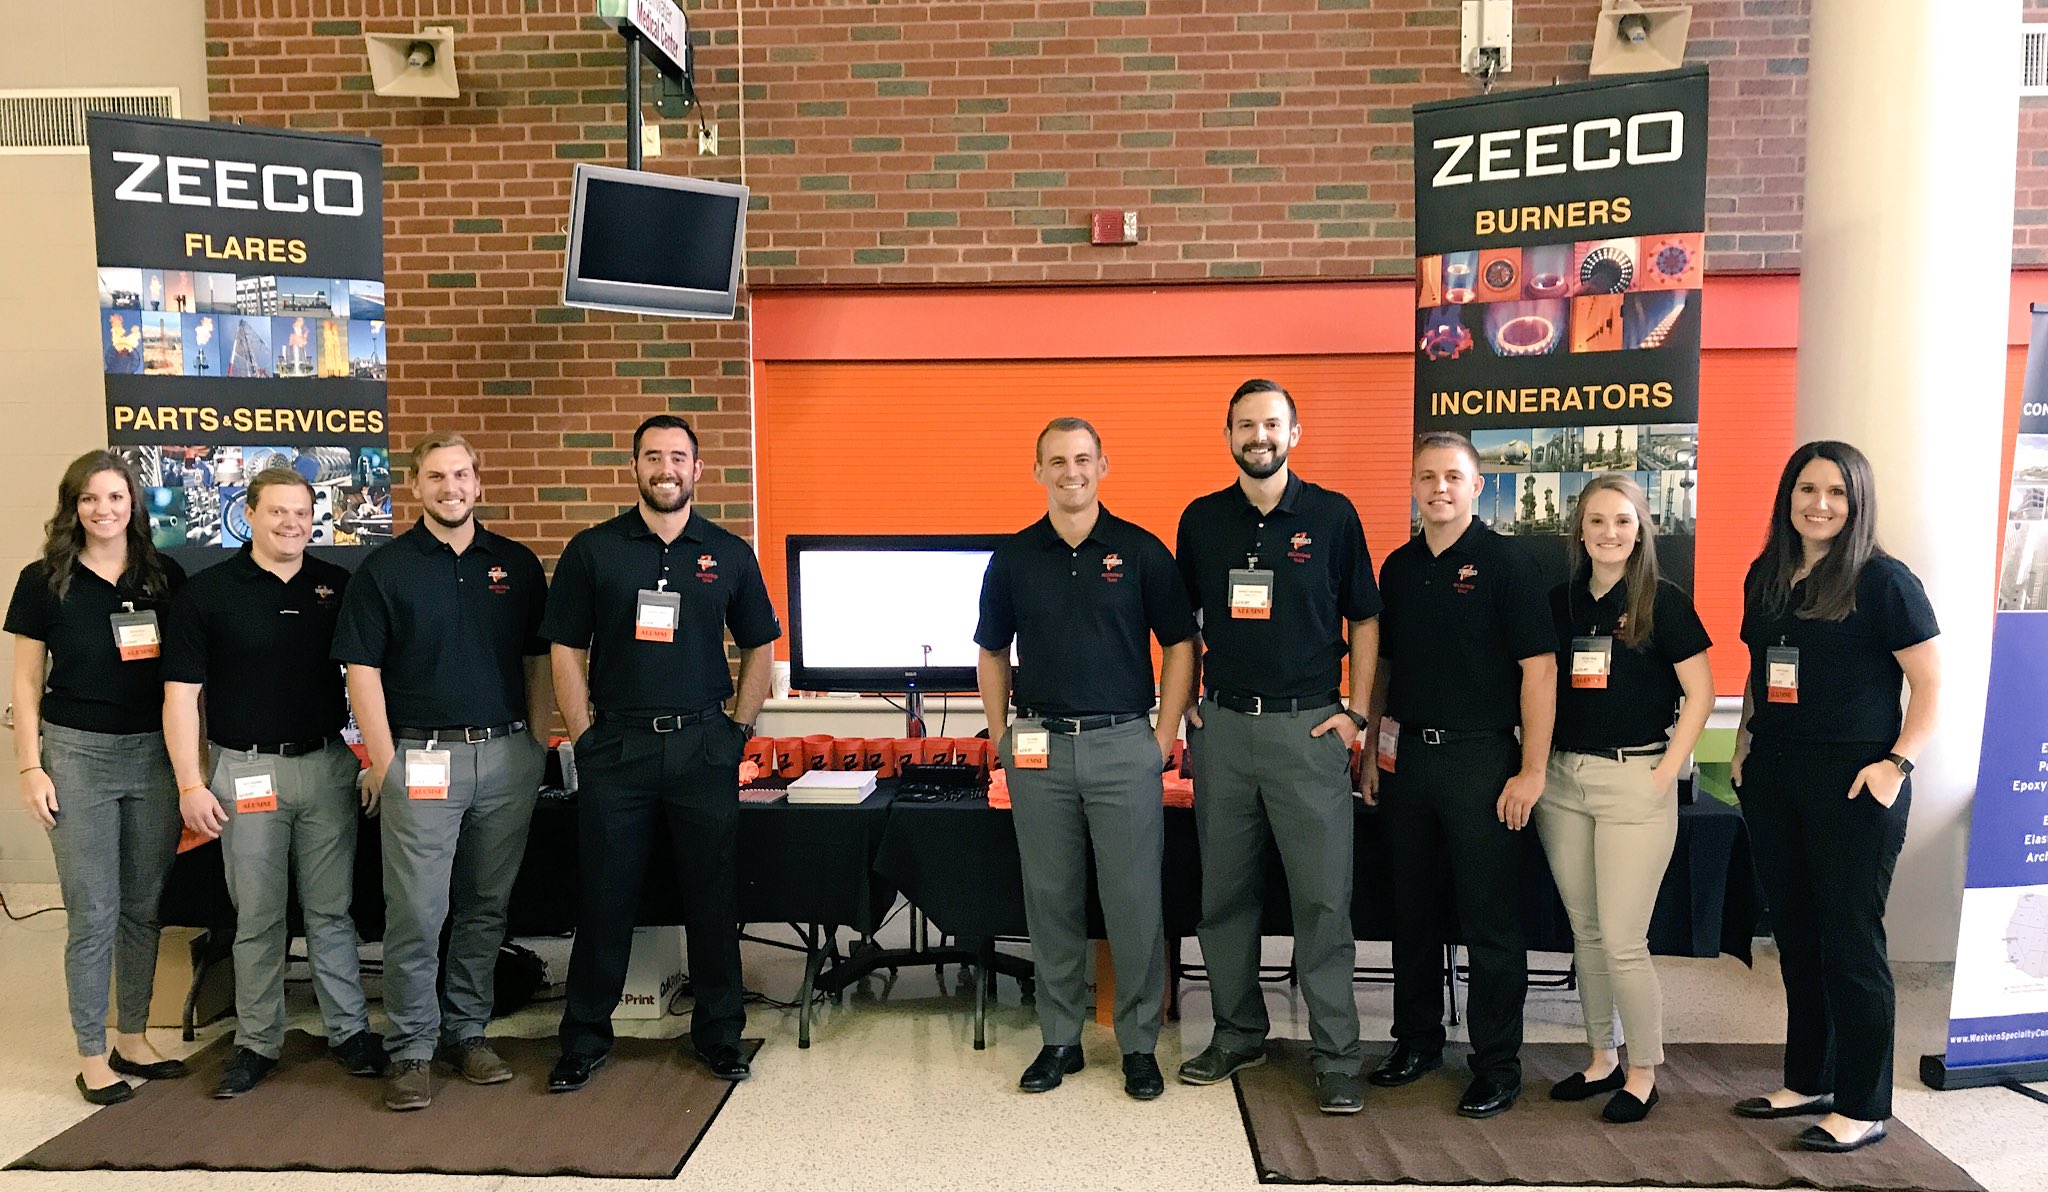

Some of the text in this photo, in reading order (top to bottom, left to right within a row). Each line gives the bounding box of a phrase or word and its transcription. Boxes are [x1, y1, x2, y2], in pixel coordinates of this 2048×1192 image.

[636, 0, 679, 59] Medical Center
[1432, 110, 1684, 188] ZEECO
[112, 151, 364, 217] ZEECO
[1475, 197, 1633, 236] BURNERS
[184, 233, 308, 264] FLARES
[1431, 381, 1674, 416] INCINERATORS
[2012, 780, 2047, 793] Epoxy
[624, 993, 655, 1005] Print
